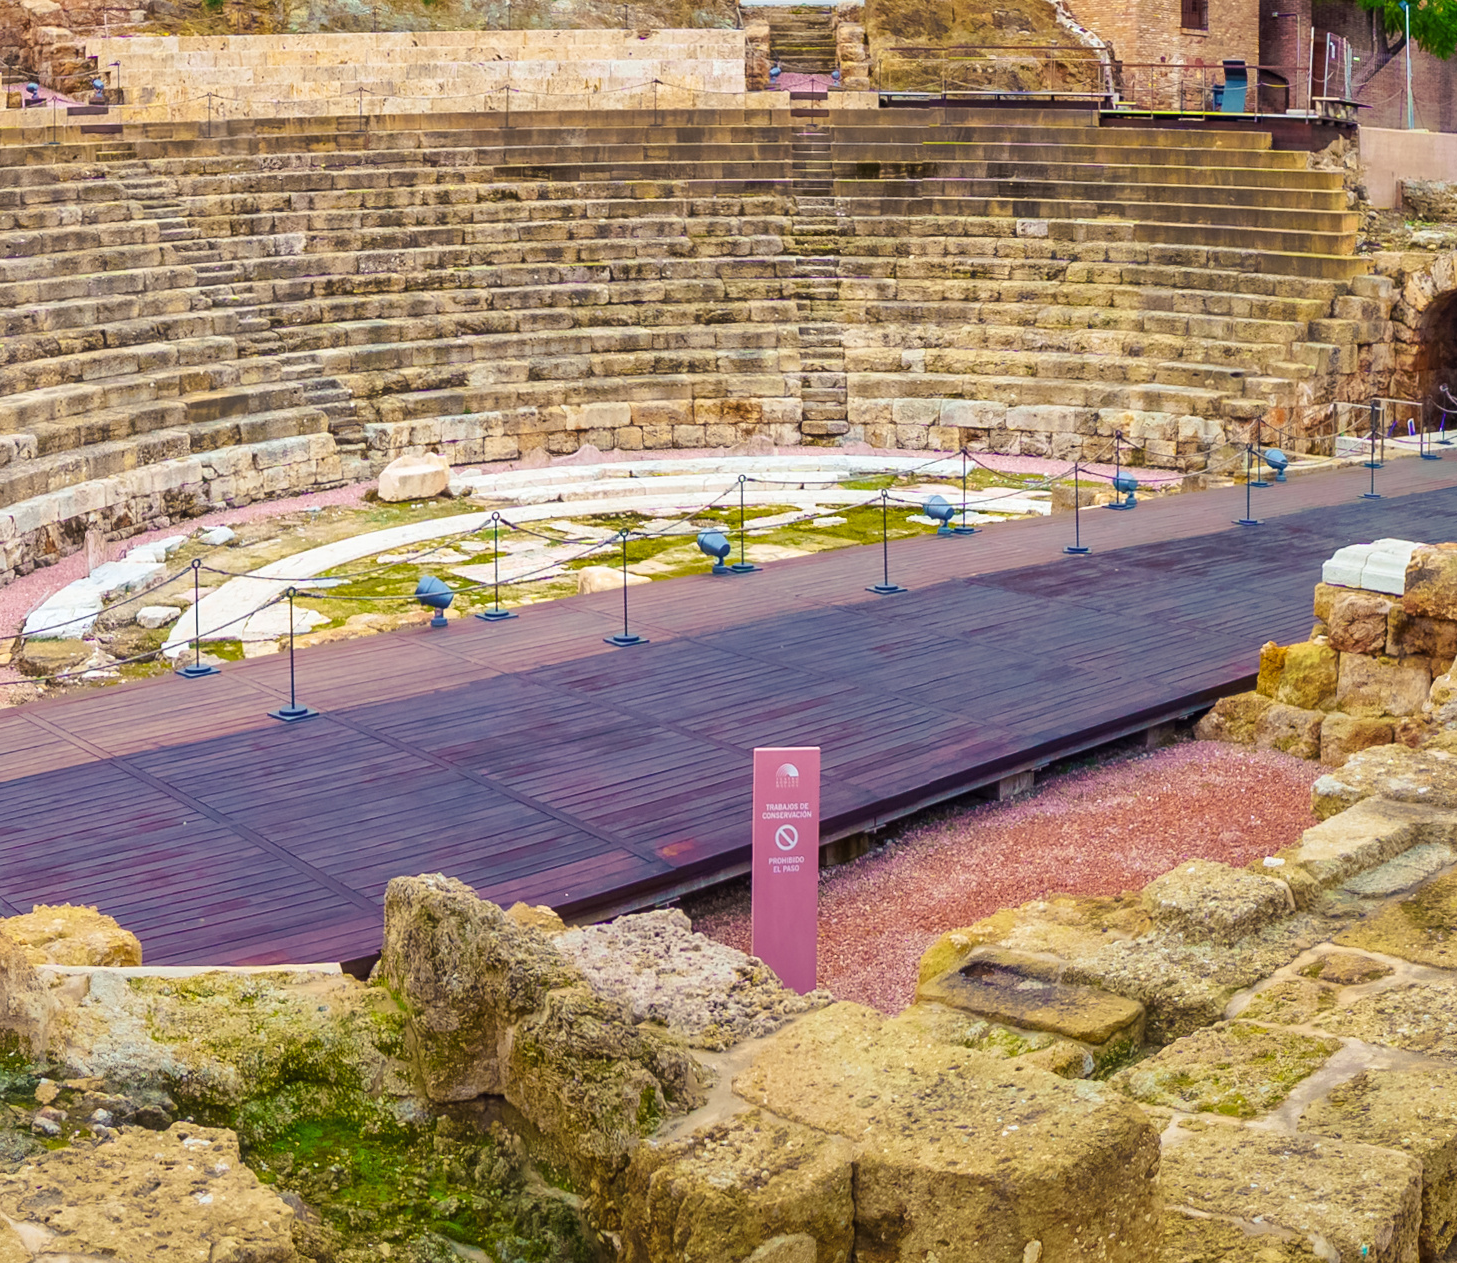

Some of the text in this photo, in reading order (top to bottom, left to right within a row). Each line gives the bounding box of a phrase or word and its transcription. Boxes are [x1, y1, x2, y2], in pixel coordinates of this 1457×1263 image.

[765, 802, 809, 811] TRABAJOS DE
[761, 810, 812, 820] CONSERVACIÓN
[768, 855, 805, 865] PROHIBIDO
[773, 864, 800, 873] EL PASO
